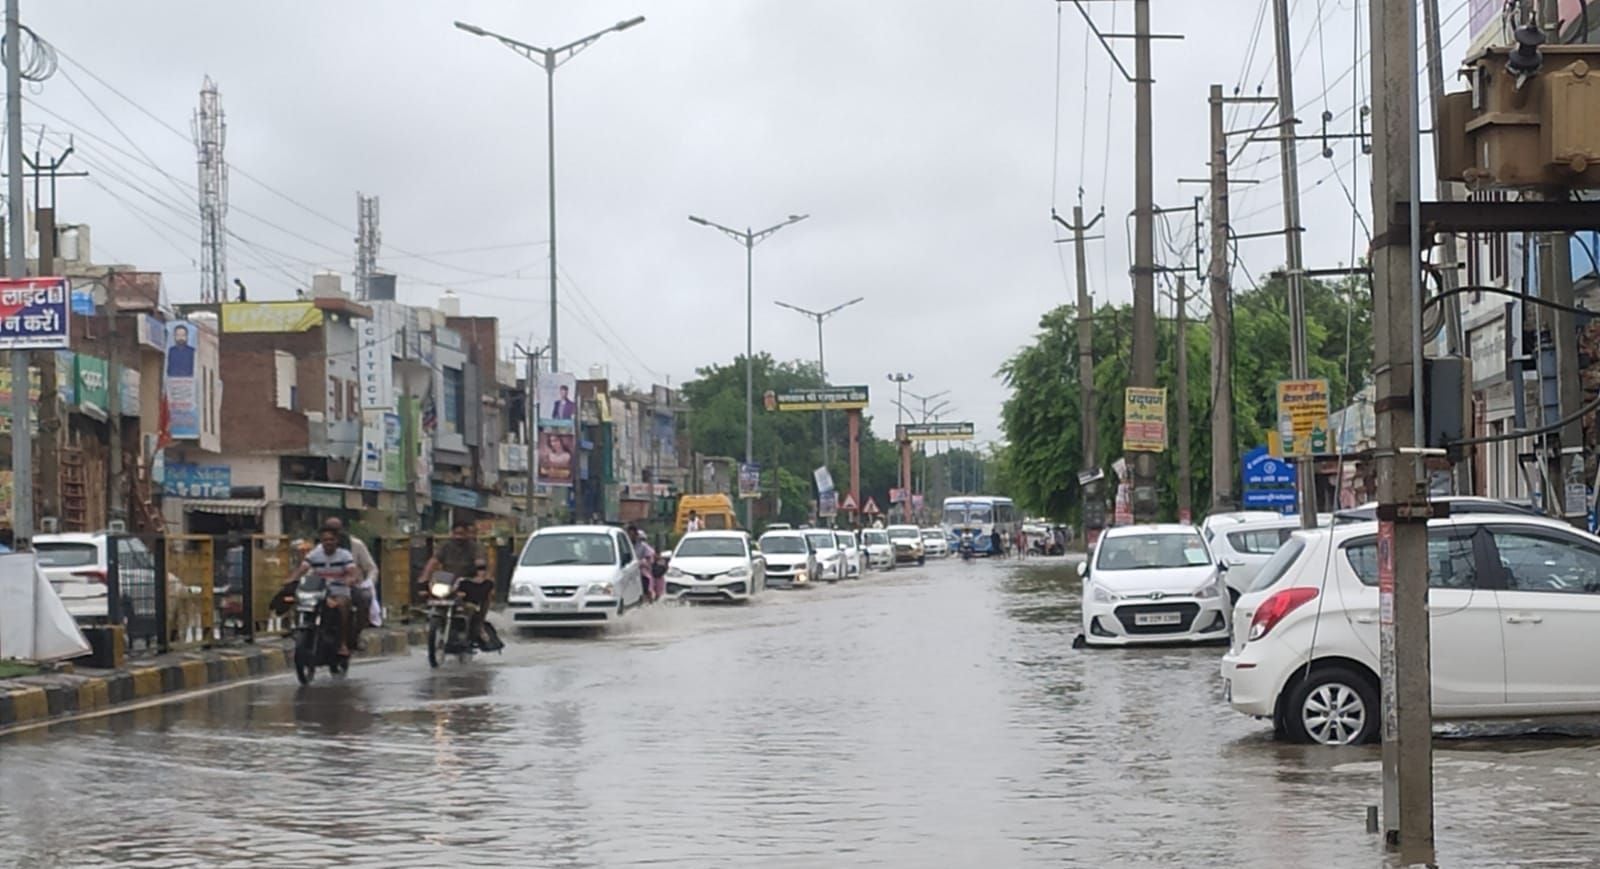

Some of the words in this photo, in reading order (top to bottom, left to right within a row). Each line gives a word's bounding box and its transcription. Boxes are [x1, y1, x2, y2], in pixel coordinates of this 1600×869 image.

[2, 283, 46, 307] लाईट
[5, 316, 21, 332] न
[23, 308, 60, 332] करें।
